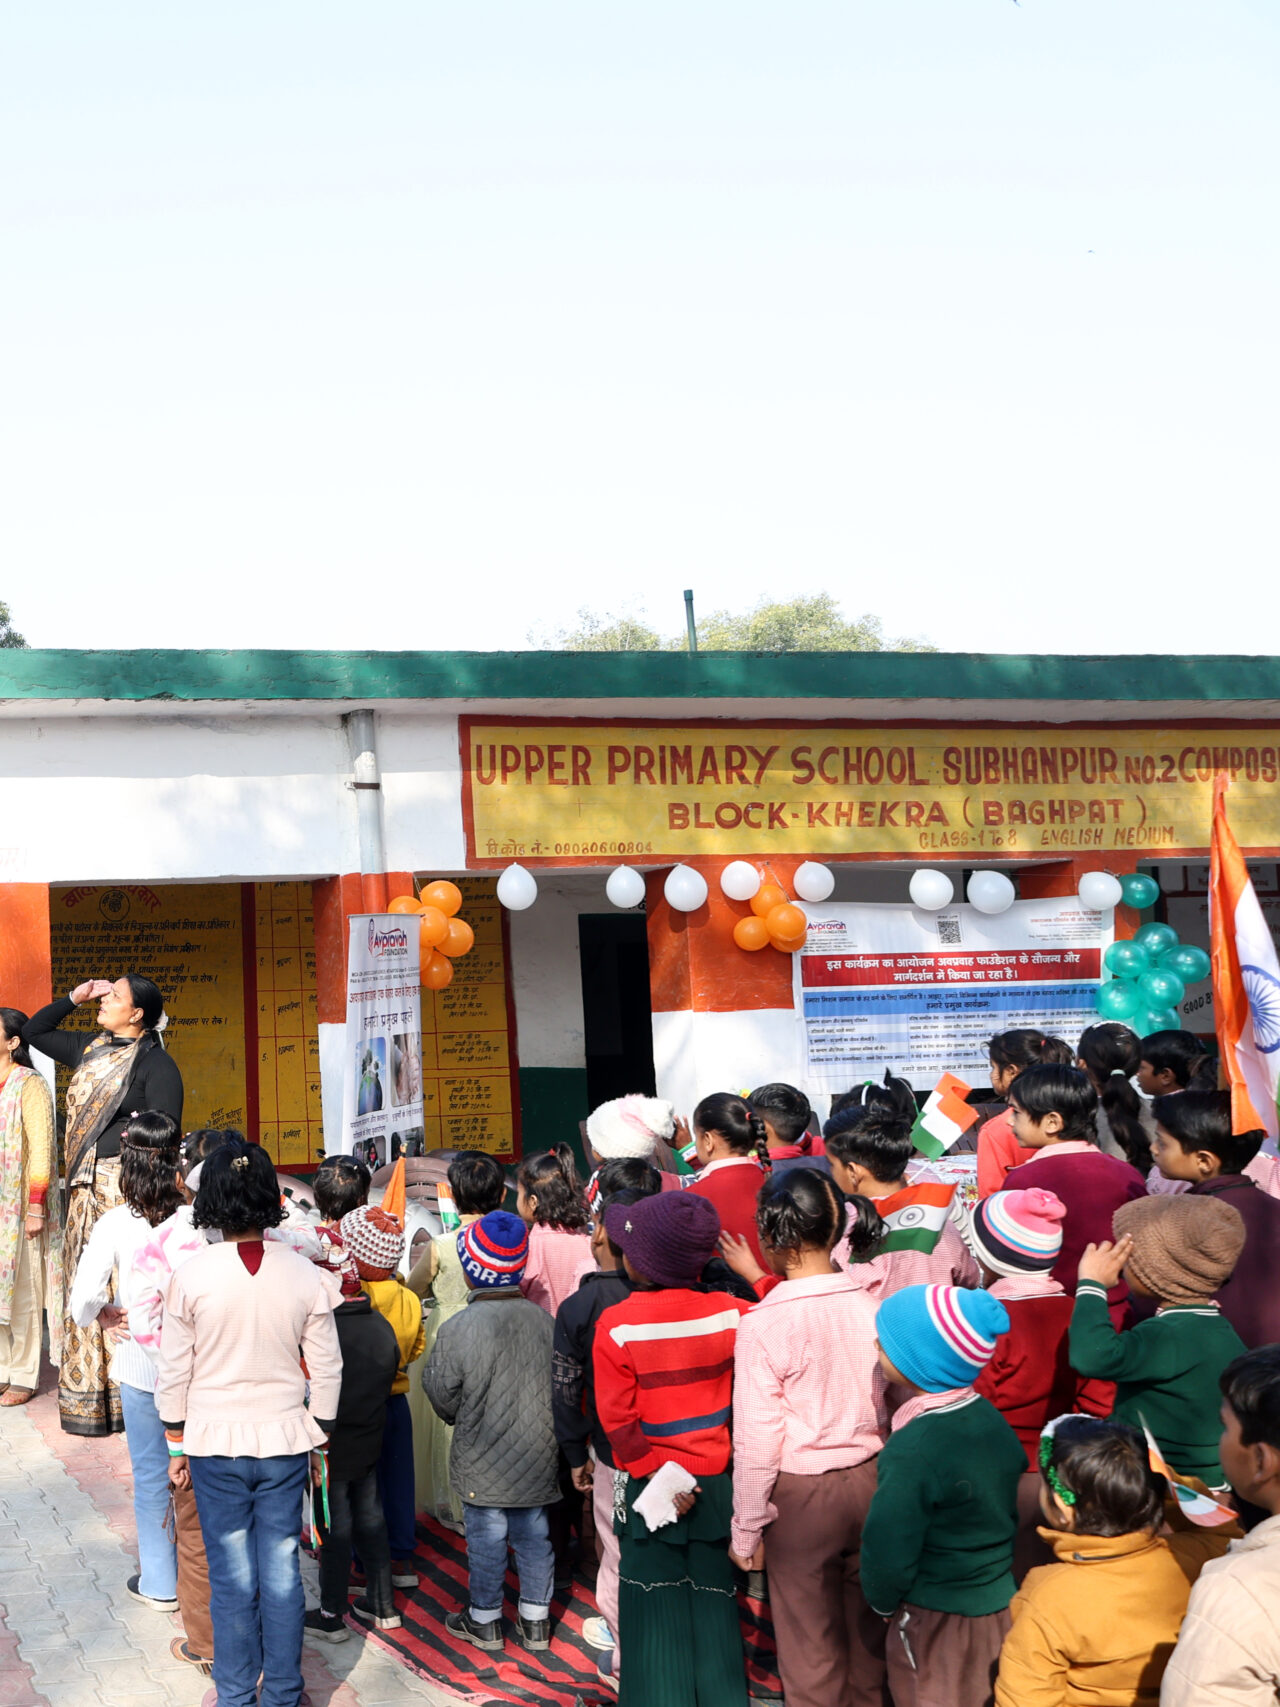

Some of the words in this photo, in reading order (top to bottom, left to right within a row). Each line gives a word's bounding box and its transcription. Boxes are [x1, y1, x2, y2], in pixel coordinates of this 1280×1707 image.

[476, 744, 591, 786] UPPER
[608, 745, 780, 786] PRIMARY
[790, 745, 930, 786] SCHOOL
[942, 746, 1122, 785] SUBHANPUR
[1124, 754, 1177, 784] NO.2
[1178, 746, 1280, 783] COMPOS
[669, 801, 950, 830] BLOCK-KHEKRA
[1041, 828, 1103, 847] ENGLISH
[807, 921, 847, 933] Avpravah
[826, 959, 842, 972] इस
[844, 955, 880, 969] कार्यक्रम
[882, 958, 894, 968] का
[896, 955, 935, 968] आयोजन
[937, 956, 974, 968] अवप्रवाह
[1018, 953, 1029, 964] के
[1031, 951, 1061, 964] सौजन्य
[1063, 951, 1081, 963] और
[893, 968, 934, 982] मार्गदर्शन
[947, 968, 970, 981] किया
[972, 969, 986, 980] जा
[987, 969, 1003, 980] रहा
[1183, 996, 1205, 1014] GOOD
[457, 1235, 499, 1284] STAR
